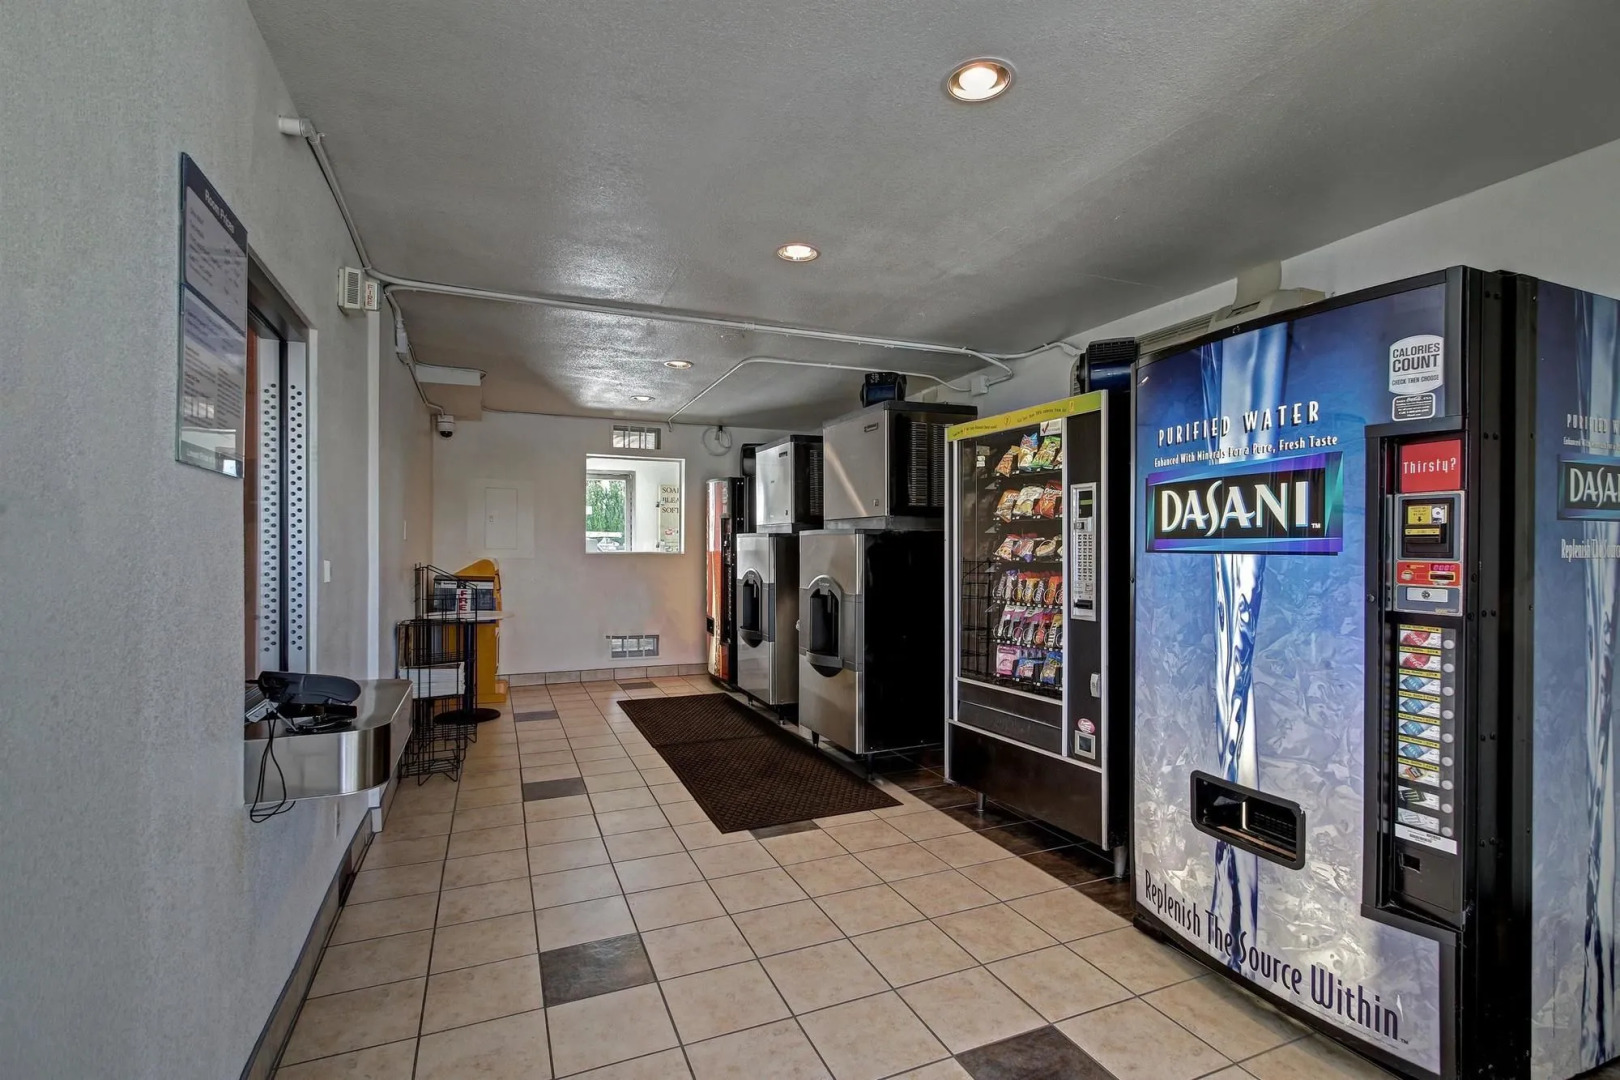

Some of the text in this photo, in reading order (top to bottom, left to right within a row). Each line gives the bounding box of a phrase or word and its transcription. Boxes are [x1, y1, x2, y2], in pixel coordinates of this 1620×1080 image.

[1393, 343, 1440, 358] CALORIES
[1393, 354, 1440, 373] COUNT
[1158, 401, 1319, 448] PURIFIED WATER
[1155, 452, 1179, 468] Enhanced
[1181, 450, 1195, 464] With
[1280, 439, 1306, 450] Fresh
[1309, 435, 1338, 448] Taste
[1404, 457, 1456, 474] Thirsty?
[1570, 467, 1620, 508] DASA
[1161, 480, 1308, 537] DASANI
[1145, 869, 1201, 937] Replenish
[1206, 909, 1233, 956] The
[1240, 931, 1302, 995] Source
[1311, 964, 1398, 1040] Within
